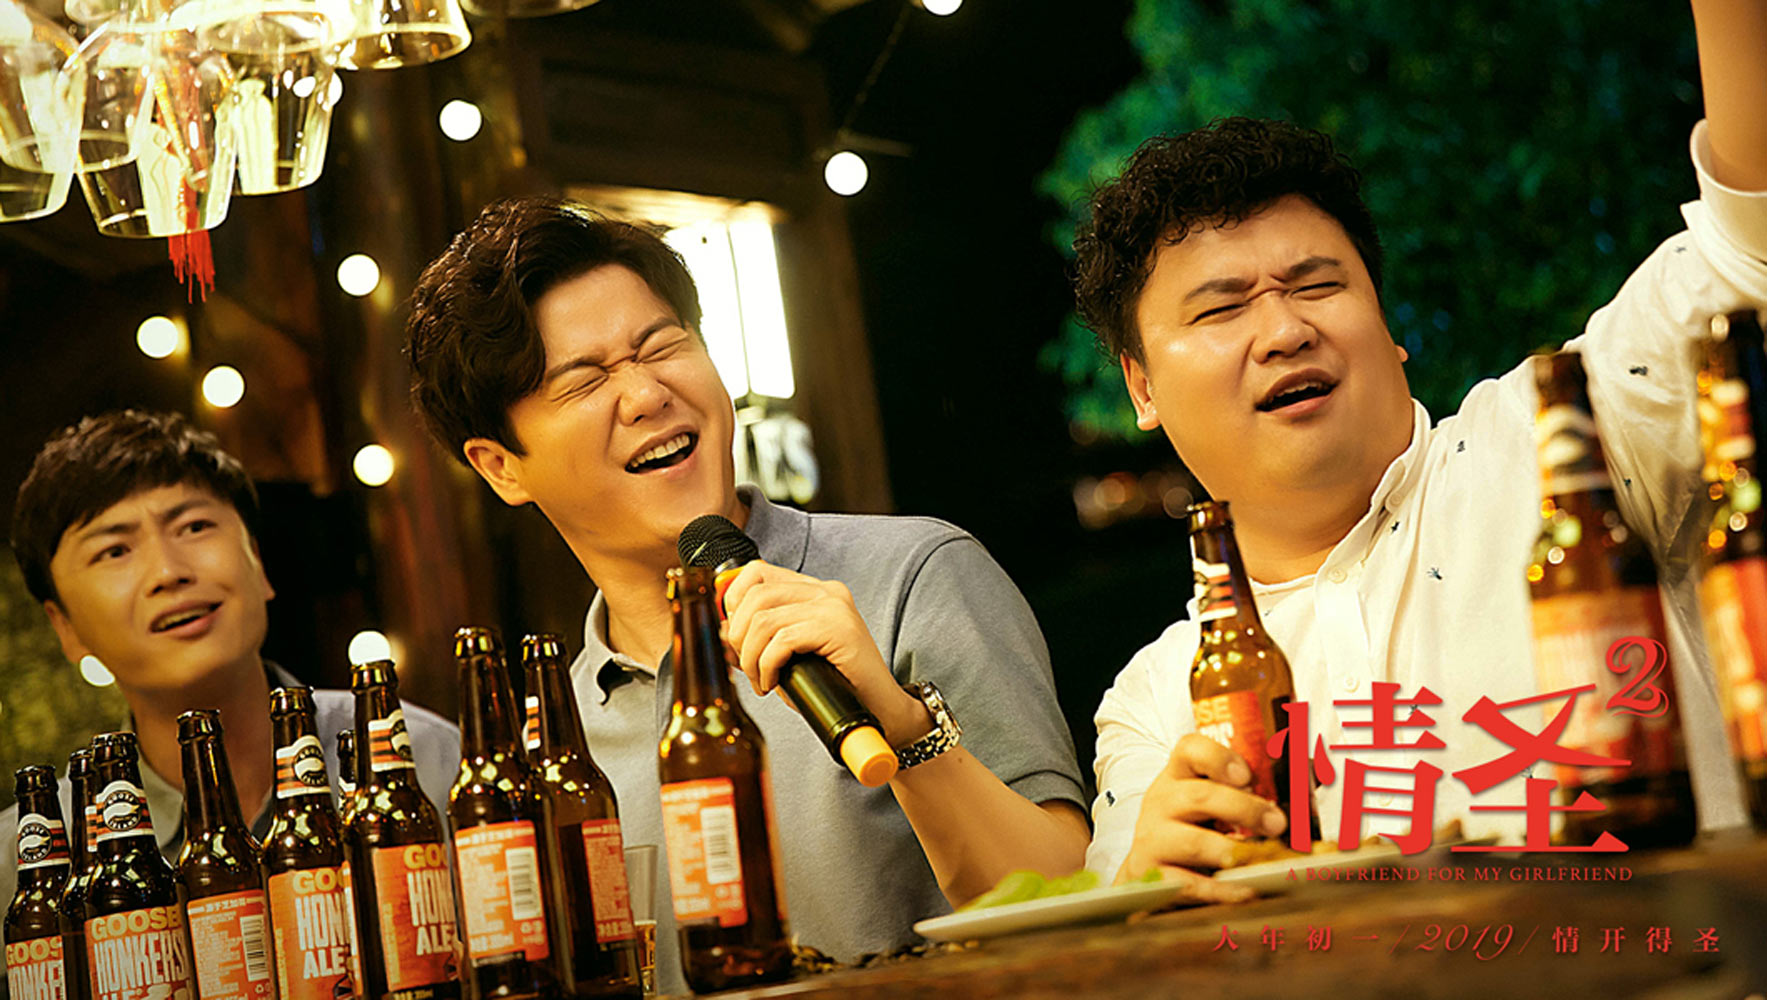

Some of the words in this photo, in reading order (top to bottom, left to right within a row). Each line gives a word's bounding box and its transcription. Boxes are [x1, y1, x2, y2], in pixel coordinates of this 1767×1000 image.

[91, 906, 181, 940] GOOSE
[94, 928, 188, 994] HONKERS
[304, 947, 346, 980] ALE
